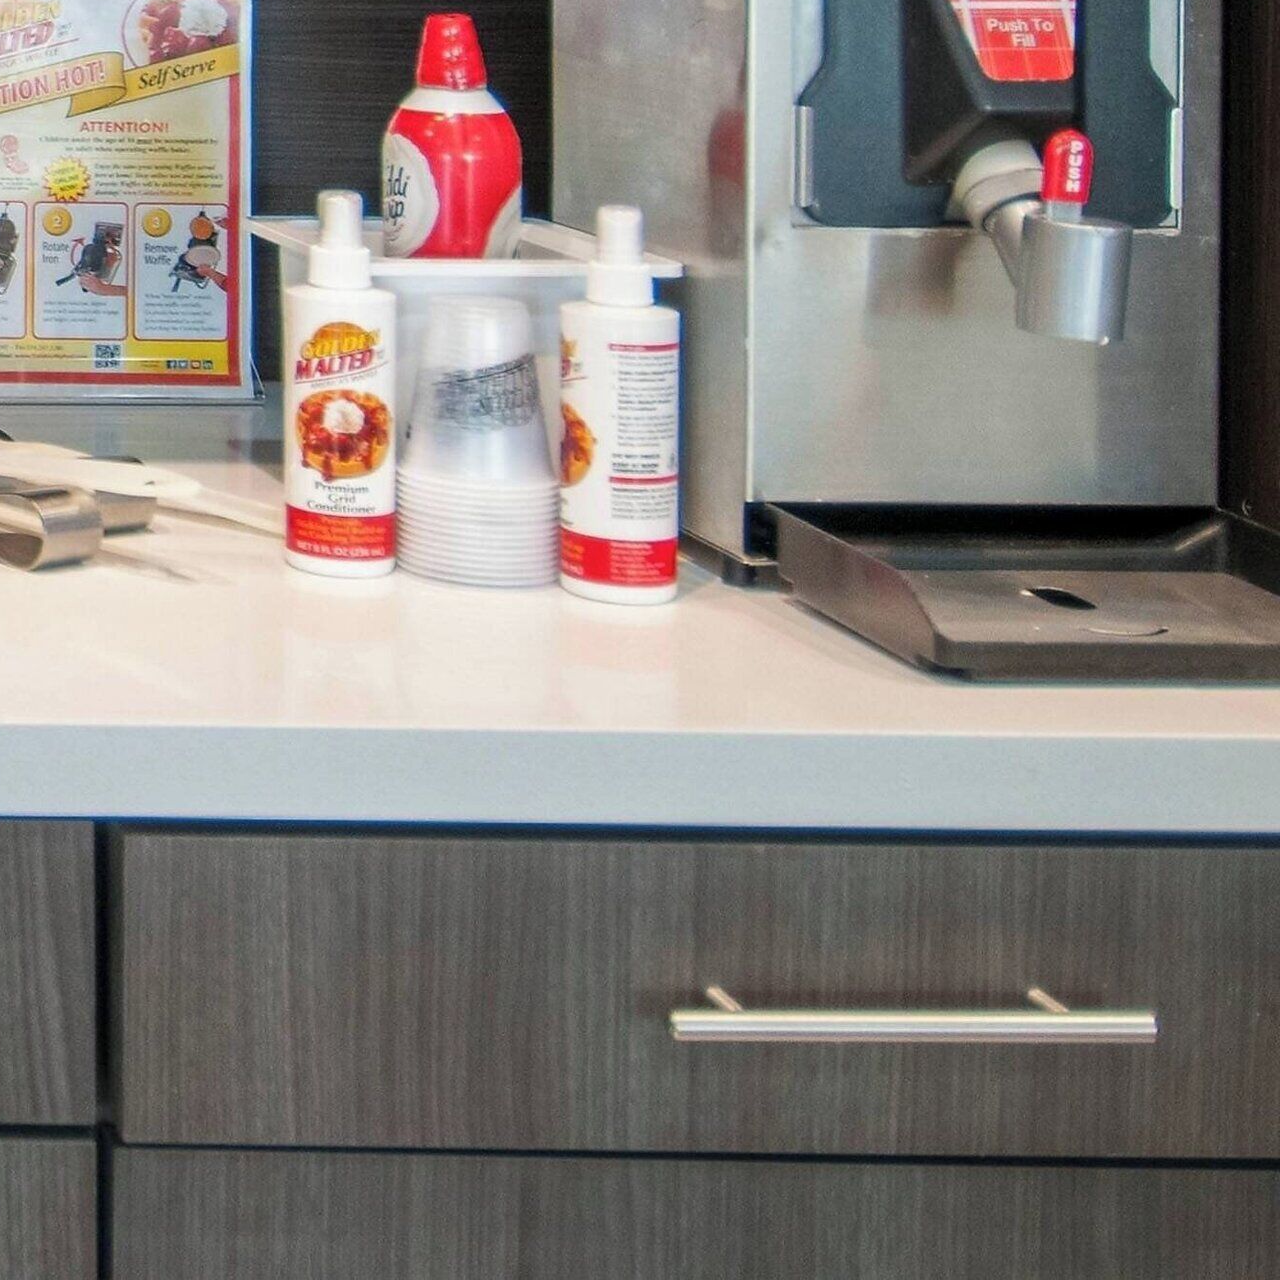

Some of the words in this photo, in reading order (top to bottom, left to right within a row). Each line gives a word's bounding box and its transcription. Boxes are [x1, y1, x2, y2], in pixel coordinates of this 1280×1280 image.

[986, 18, 1028, 32] Push
[1031, 18, 1055, 32] To
[1012, 33, 1037, 47] Fill
[56, 60, 106, 92] HOT!
[139, 66, 171, 90] Self
[171, 58, 217, 82] Serve
[79, 121, 170, 134] ATTENTION!
[1067, 140, 1083, 194] PUSH
[52, 215, 63, 228] 2
[152, 216, 161, 228] 3
[42, 241, 70, 252] Rotate
[144, 243, 178, 254] Remove
[42, 254, 59, 264] Iron
[144, 255, 172, 266] Waffle
[301, 328, 380, 361] GOLDEN
[295, 348, 374, 380] MALTED
[314, 481, 370, 494] Premium
[327, 494, 356, 504] Grid
[306, 500, 376, 513] Conditioner
